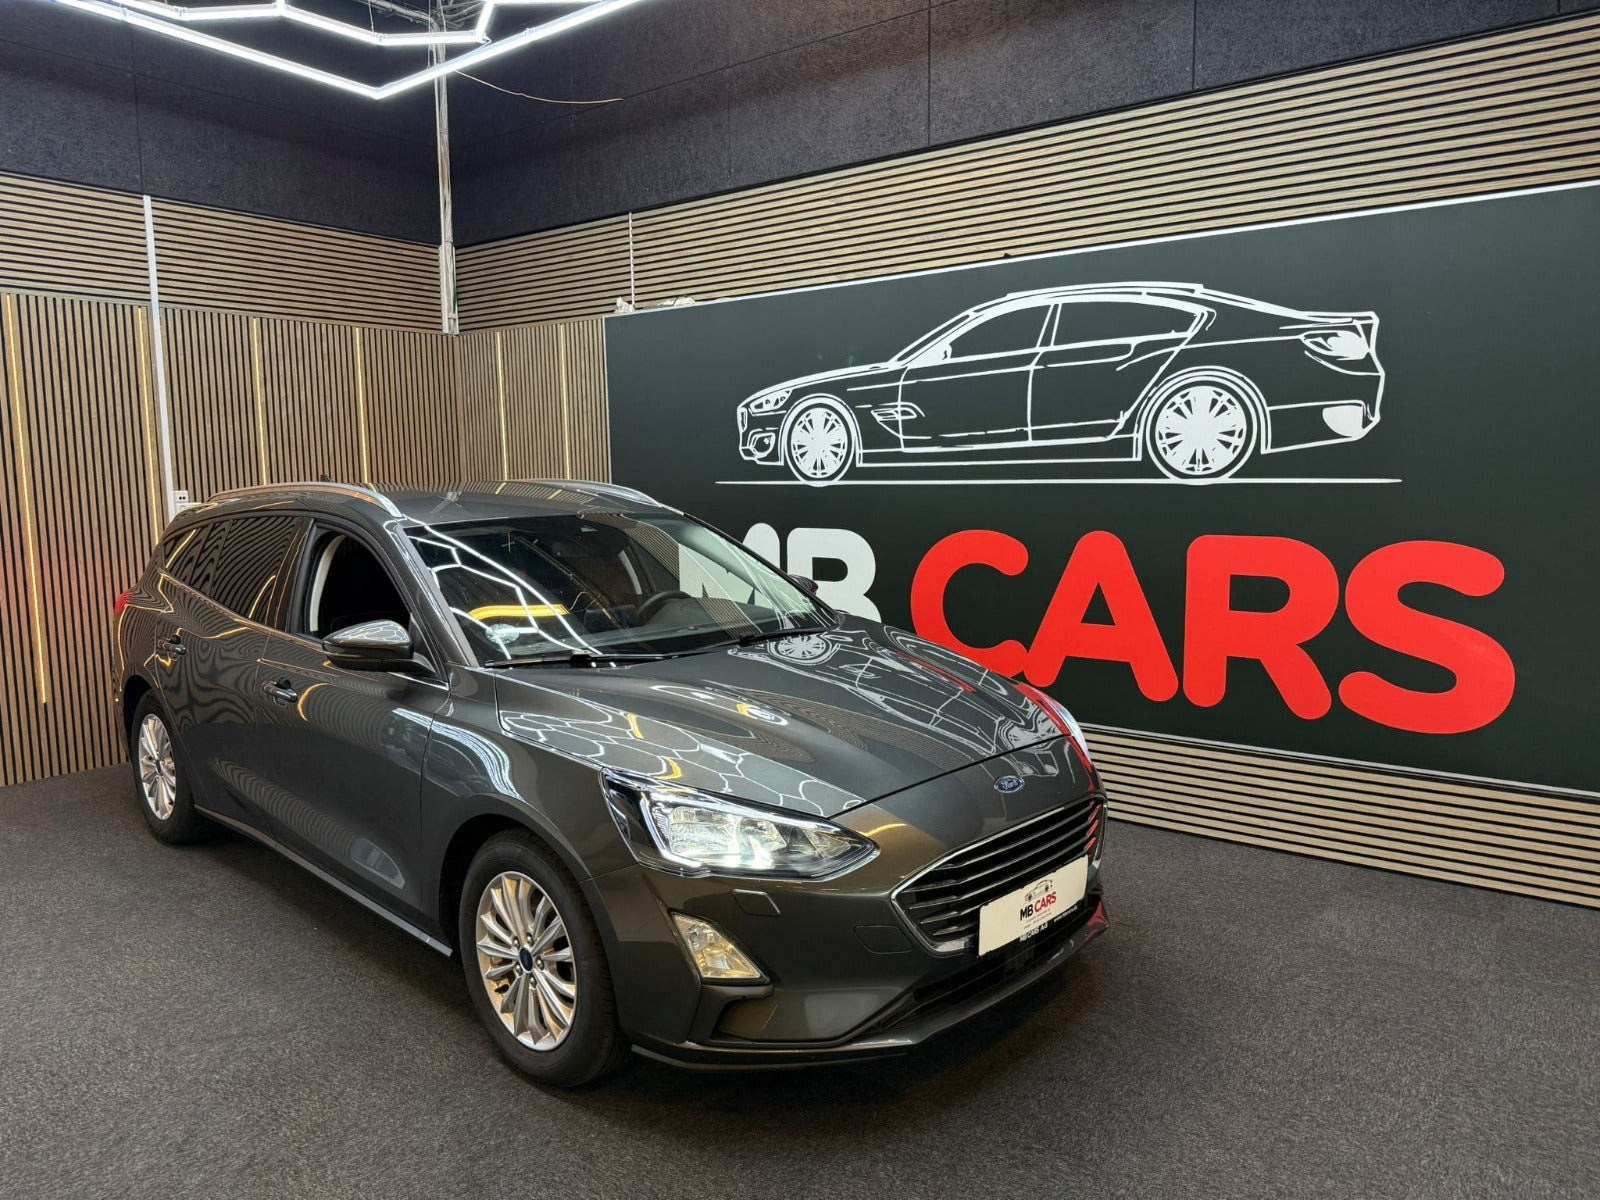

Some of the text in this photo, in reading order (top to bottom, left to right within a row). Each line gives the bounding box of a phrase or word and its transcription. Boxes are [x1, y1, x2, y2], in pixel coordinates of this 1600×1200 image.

[911, 529, 1516, 734] CARS
[1020, 904, 1034, 921] MB
[1034, 891, 1057, 913] CARS
